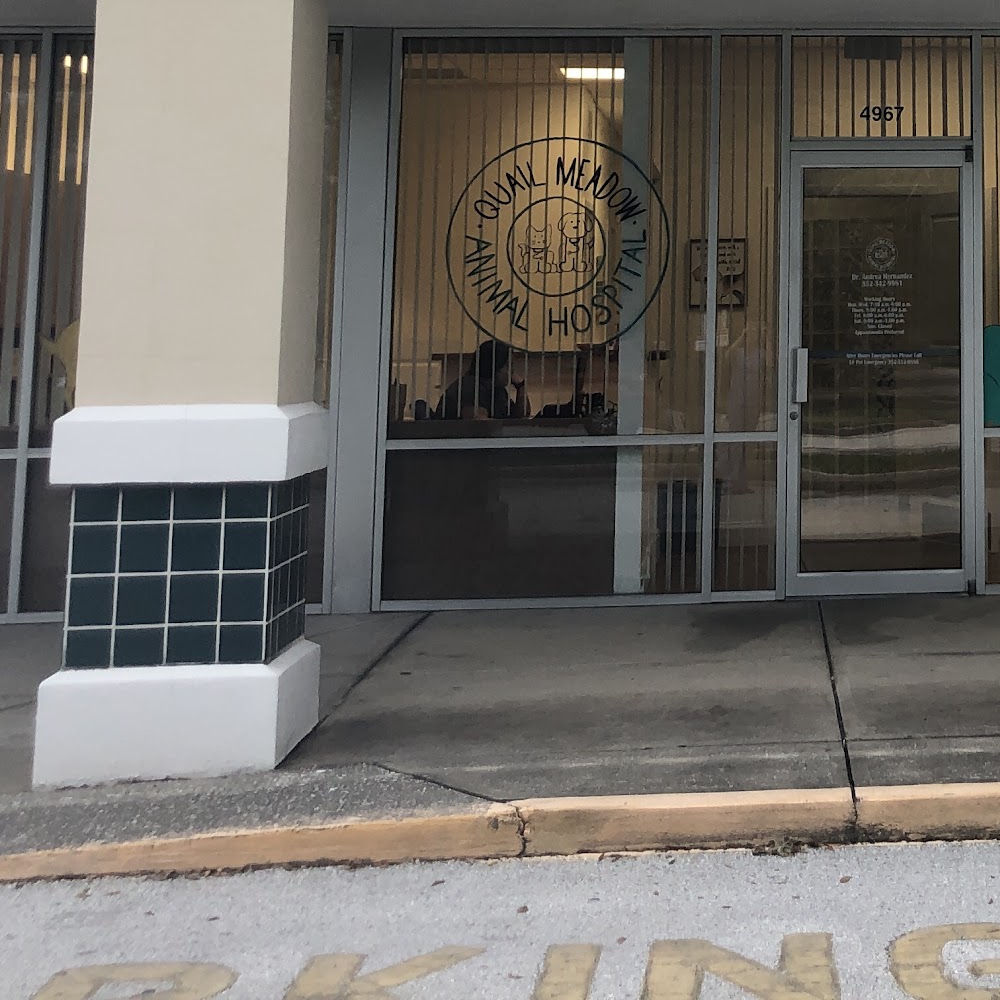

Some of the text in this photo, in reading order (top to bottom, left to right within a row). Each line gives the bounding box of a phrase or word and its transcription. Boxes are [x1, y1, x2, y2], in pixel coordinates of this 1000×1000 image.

[859, 106, 905, 122] 4967
[473, 156, 646, 222] QUAIL MEADOW
[465, 229, 646, 337] ANIMAL HOSPITAL
